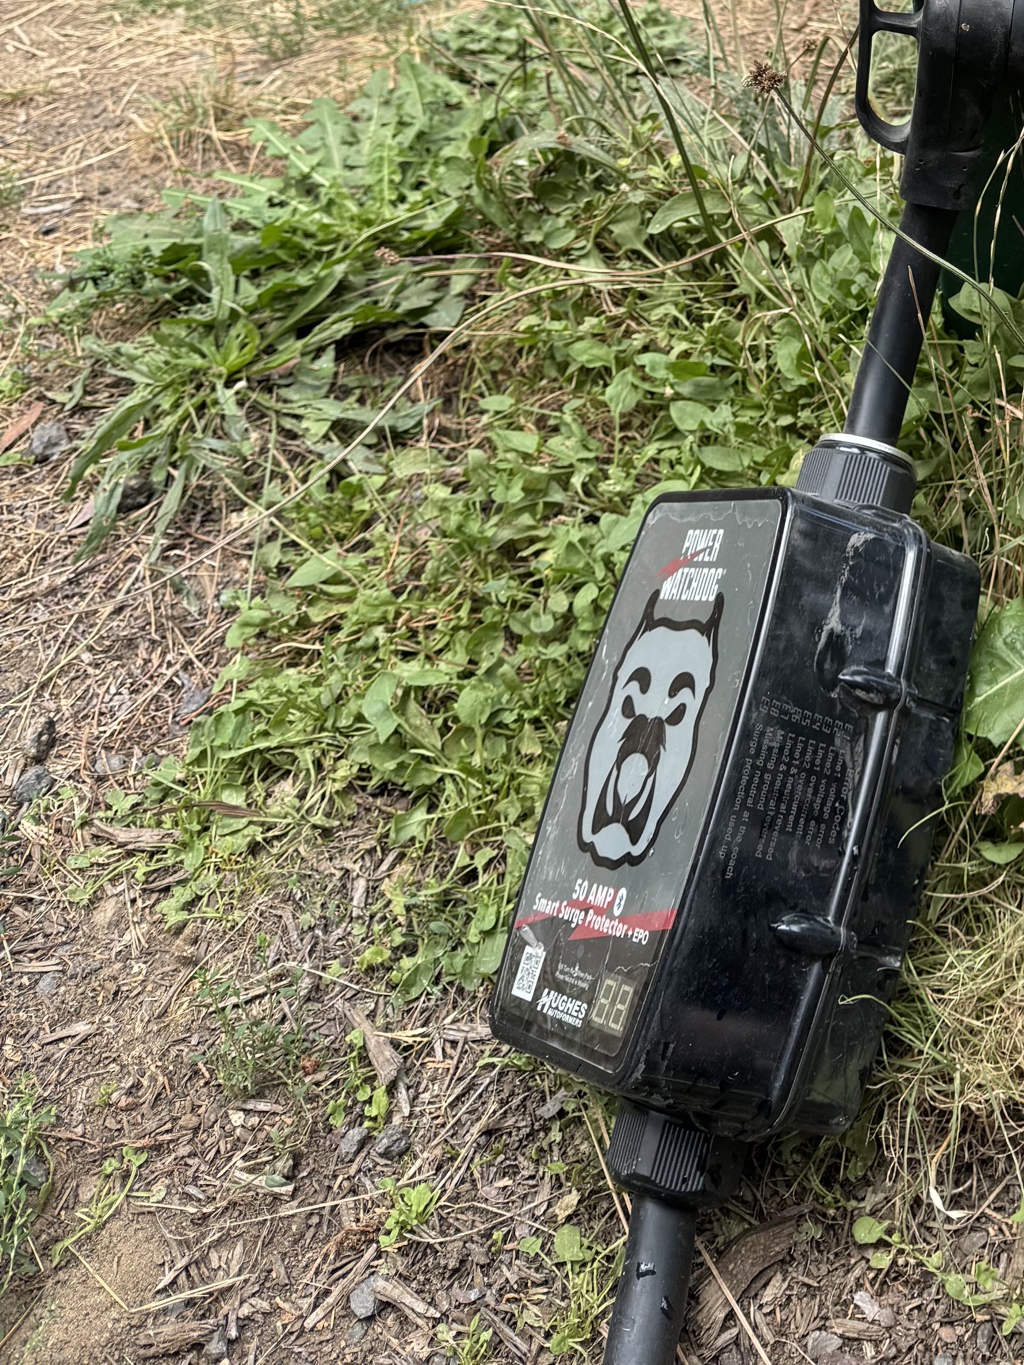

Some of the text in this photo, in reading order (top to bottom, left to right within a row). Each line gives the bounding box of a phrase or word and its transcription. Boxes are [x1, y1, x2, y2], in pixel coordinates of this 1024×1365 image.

[680, 528, 723, 561] POWER
[766, 727, 784, 769] Missing
[781, 732, 795, 762] Line2
[823, 746, 836, 775] Line2
[833, 749, 847, 777] Line1
[718, 695, 770, 859] E9 Surge protection used up
[724, 699, 781, 878] E8 Missing neutral at the coach
[765, 709, 812, 860] E5 Line1 & neutral reversed
[768, 772, 783, 809] neutral
[785, 713, 822, 831] E4 Line2 overcurrent
[796, 716, 832, 834] E3 Line1 overcurrent
[756, 773, 771, 810] ground
[813, 778, 826, 816] voltage
[822, 782, 836, 819] voltage
[754, 811, 775, 857] reversed
[804, 820, 815, 845] error
[815, 823, 825, 849] error
[828, 804, 844, 843] Codes
[571, 878, 615, 909] 50 AMP
[532, 892, 559, 916] Smart
[558, 900, 584, 927] Surge
[585, 908, 627, 938] Protector
[632, 927, 650, 945] EPO
[535, 987, 588, 1019] HUGHES
